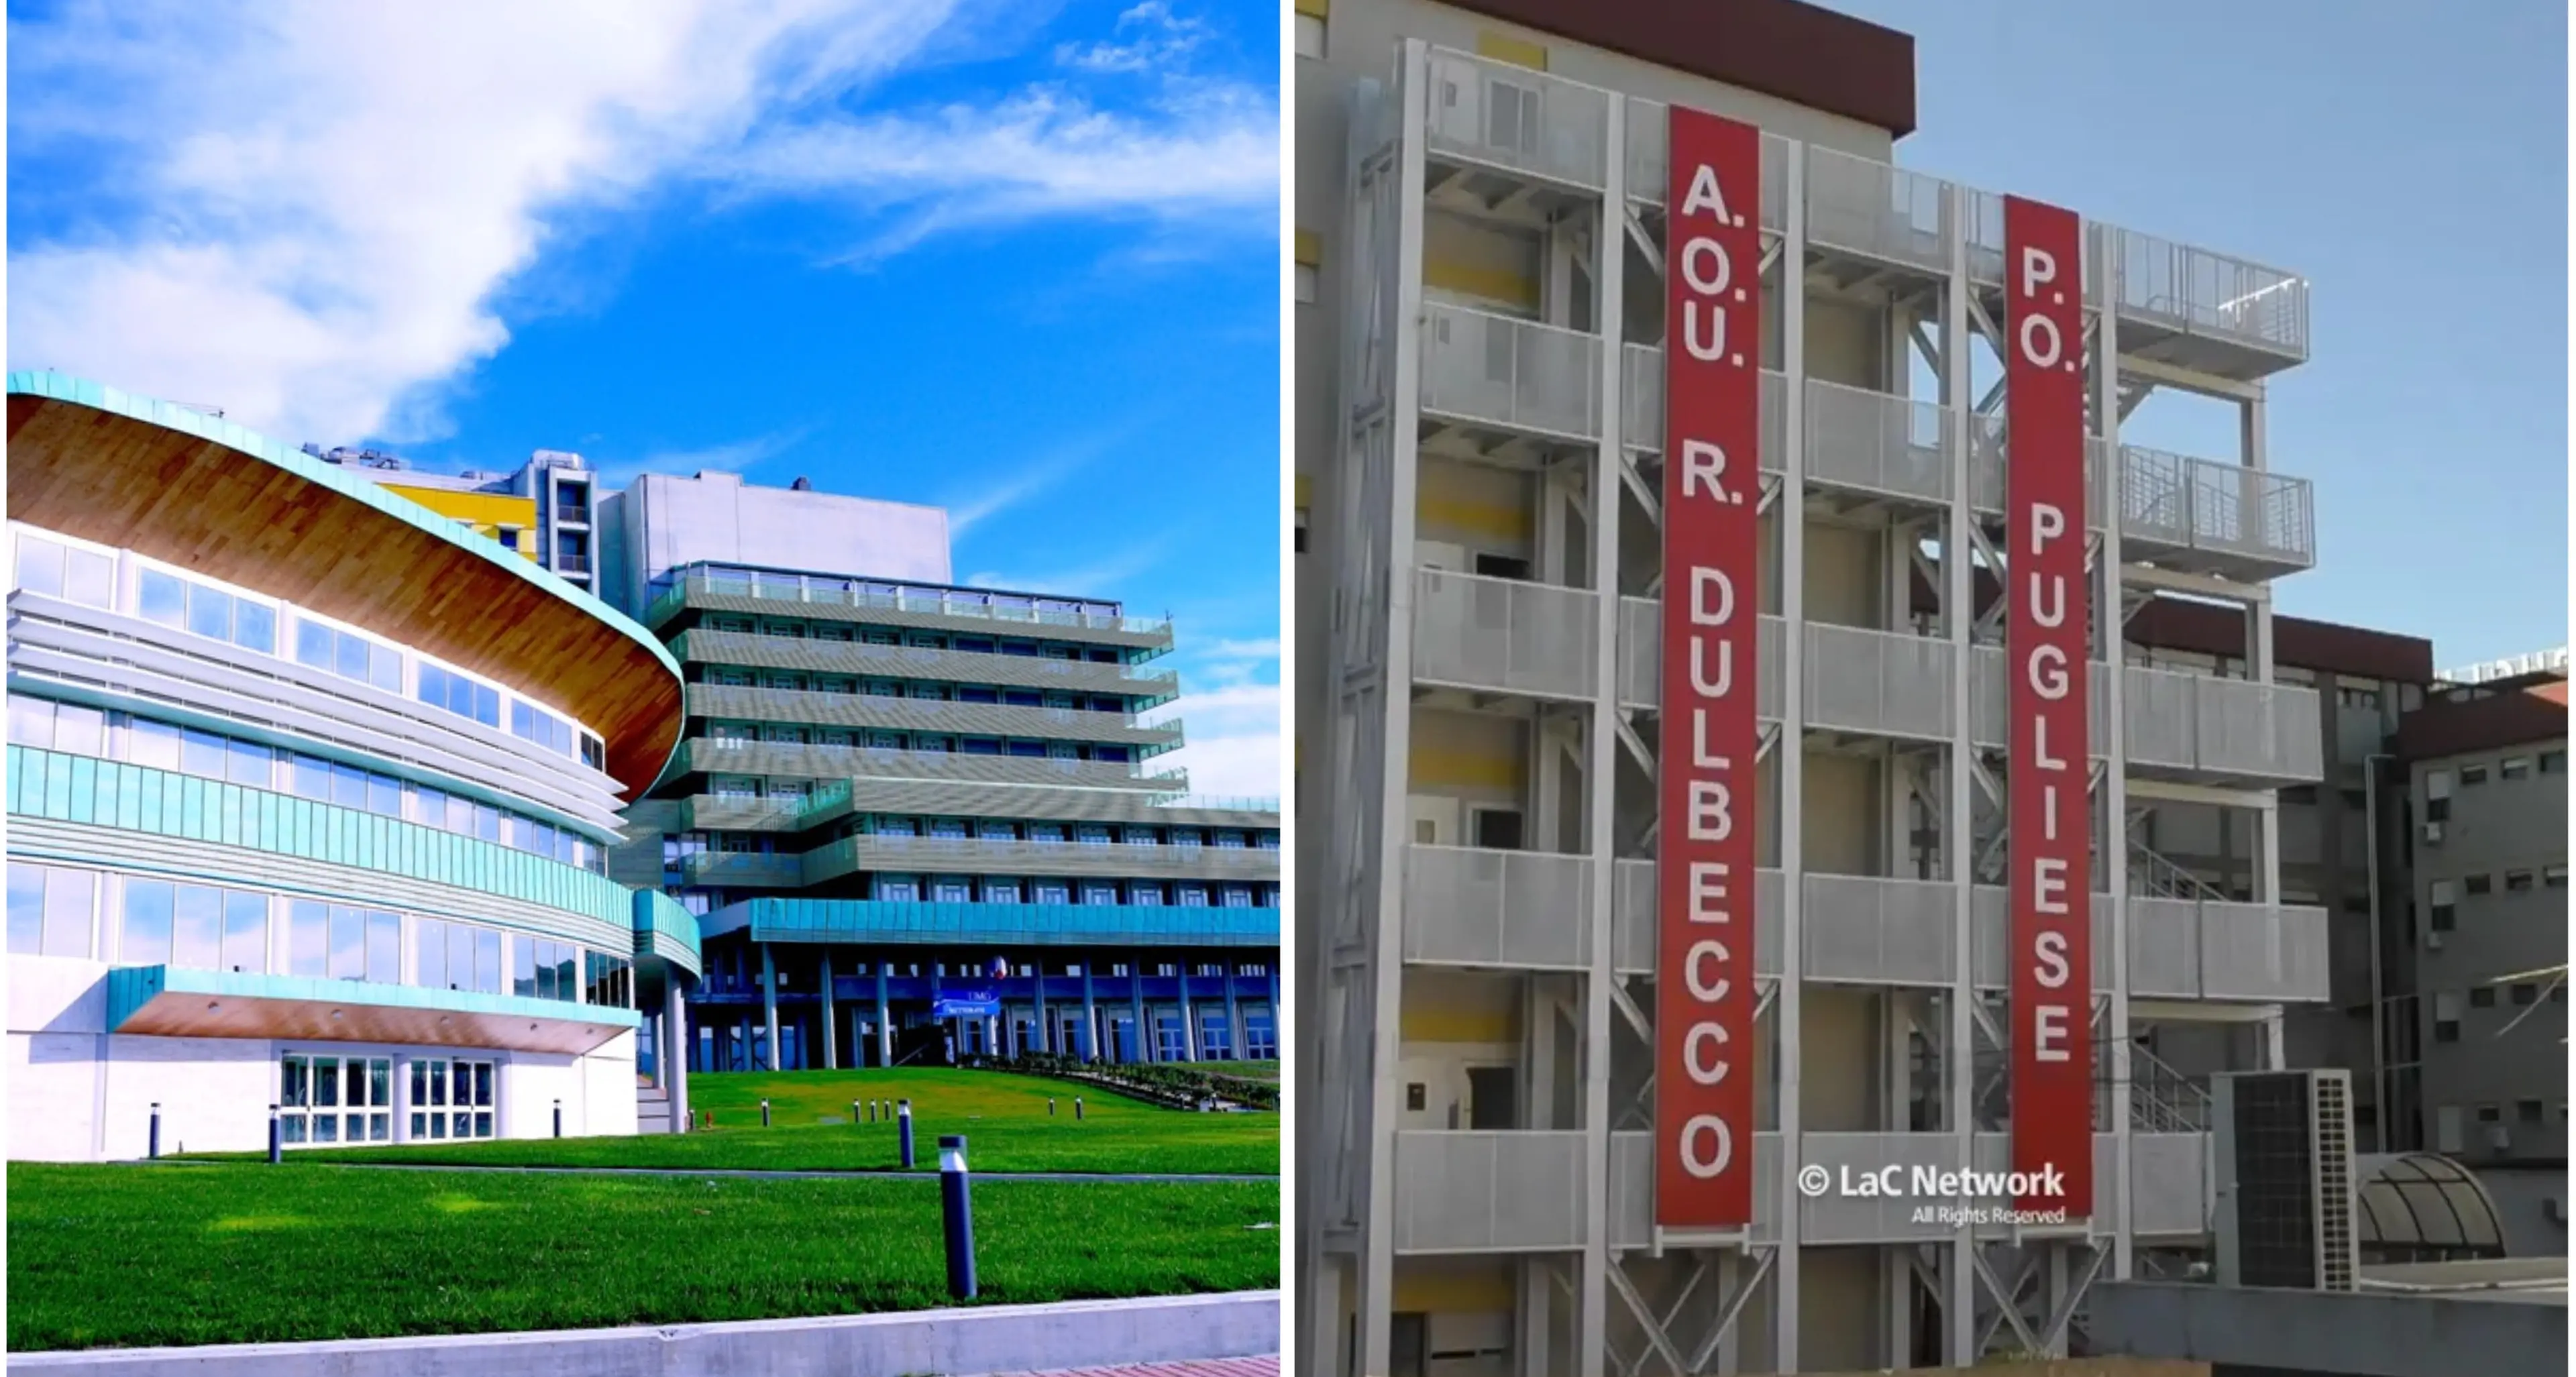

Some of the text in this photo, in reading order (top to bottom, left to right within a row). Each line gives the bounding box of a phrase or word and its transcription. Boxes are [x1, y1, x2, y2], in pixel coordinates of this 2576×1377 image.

[1681, 438, 1744, 506] R.
[1680, 565, 1735, 1178] DULBECCO
[2029, 502, 2071, 1062] PUGLIESE
